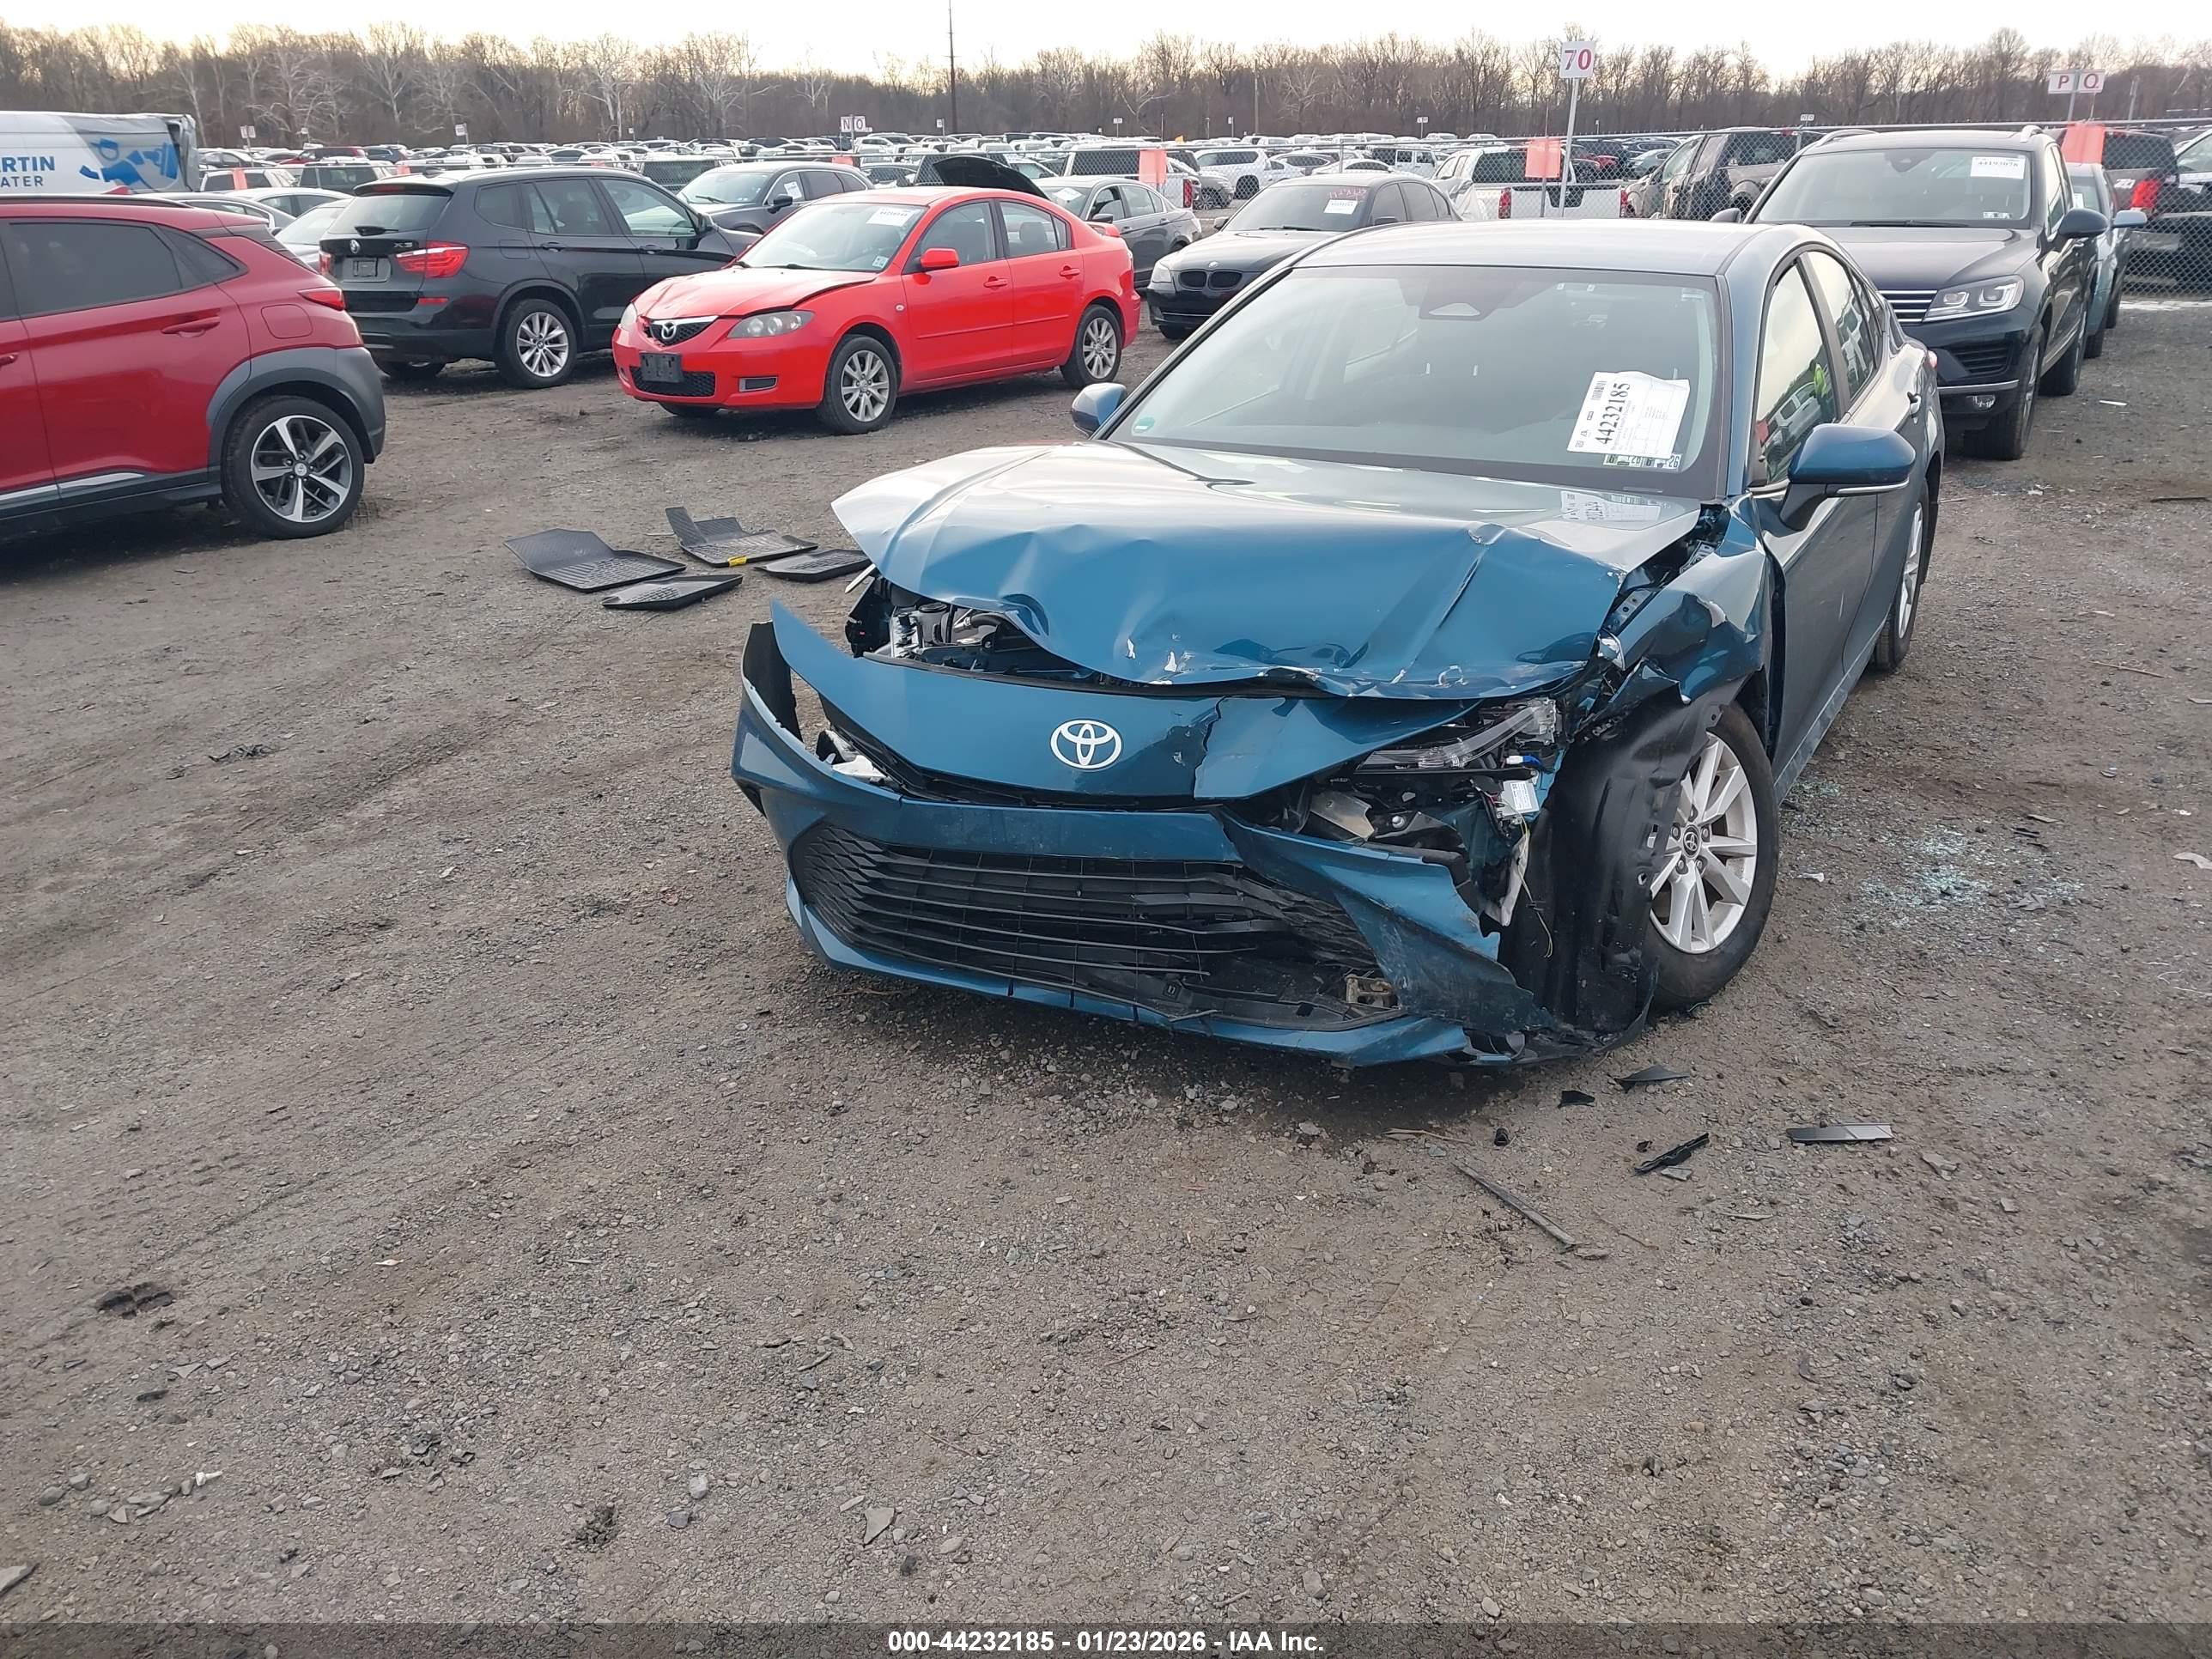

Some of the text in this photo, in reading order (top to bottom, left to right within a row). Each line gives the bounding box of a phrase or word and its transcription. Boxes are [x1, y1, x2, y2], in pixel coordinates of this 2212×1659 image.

[1565, 48, 1592, 70] 70
[2057, 73, 2100, 89] P Q
[843, 118, 864, 130] N O
[0, 156, 56, 173] RTIN
[1595, 382, 1632, 445] 44232185
[1668, 455, 1680, 468] 26
